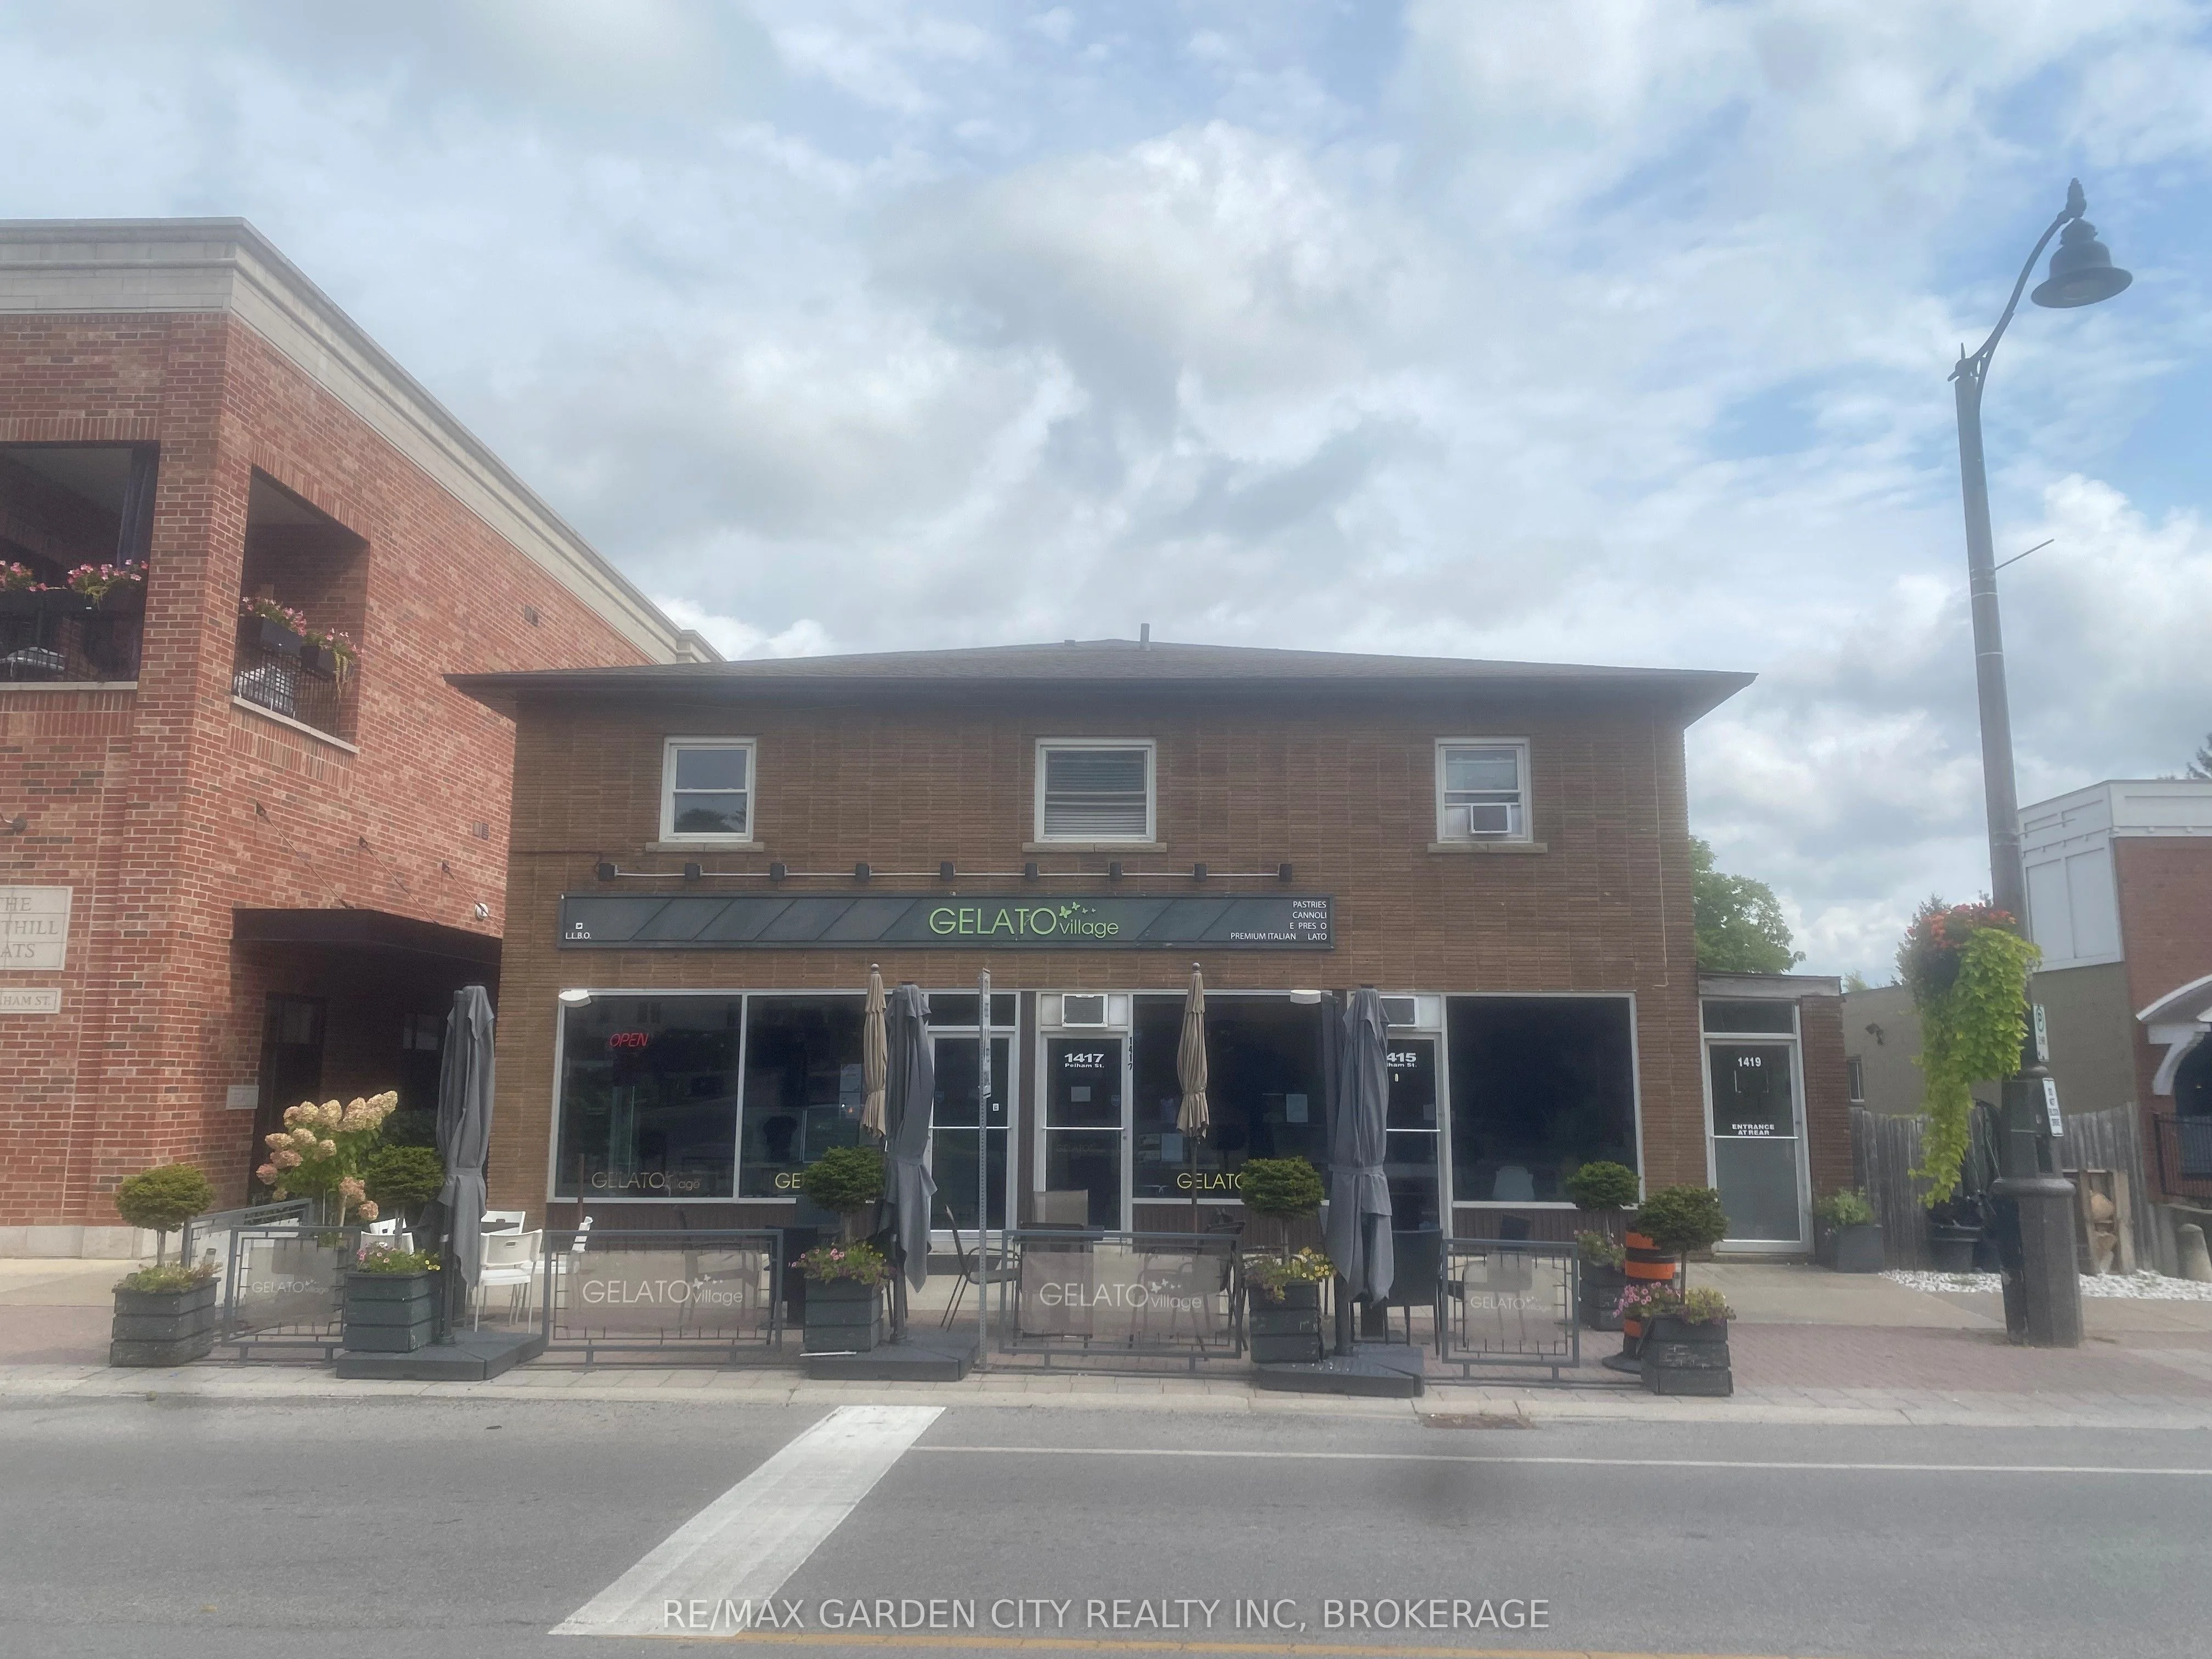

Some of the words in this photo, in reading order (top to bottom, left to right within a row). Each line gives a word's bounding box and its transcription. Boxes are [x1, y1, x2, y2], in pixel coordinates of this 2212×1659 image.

[0, 897, 31, 911] HE
[0, 921, 59, 935] THILL
[929, 908, 1057, 934] GELATO
[1059, 919, 1119, 938] village
[0, 944, 35, 958] ATS
[0, 996, 32, 1006] HAM
[610, 1032, 649, 1047] OPEN
[1064, 1053, 1104, 1063] 1417
[1387, 1052, 1417, 1063] 415
[1737, 1057, 1762, 1067] 1419
[591, 1172, 665, 1189] GELATO
[252, 1282, 304, 1293] GELATO
[583, 1280, 691, 1304] GELATO
[693, 1289, 743, 1306] village
[1040, 1283, 1149, 1308] GELATO
[1151, 1294, 1202, 1312] village
[1470, 1296, 1525, 1310] GELATO
